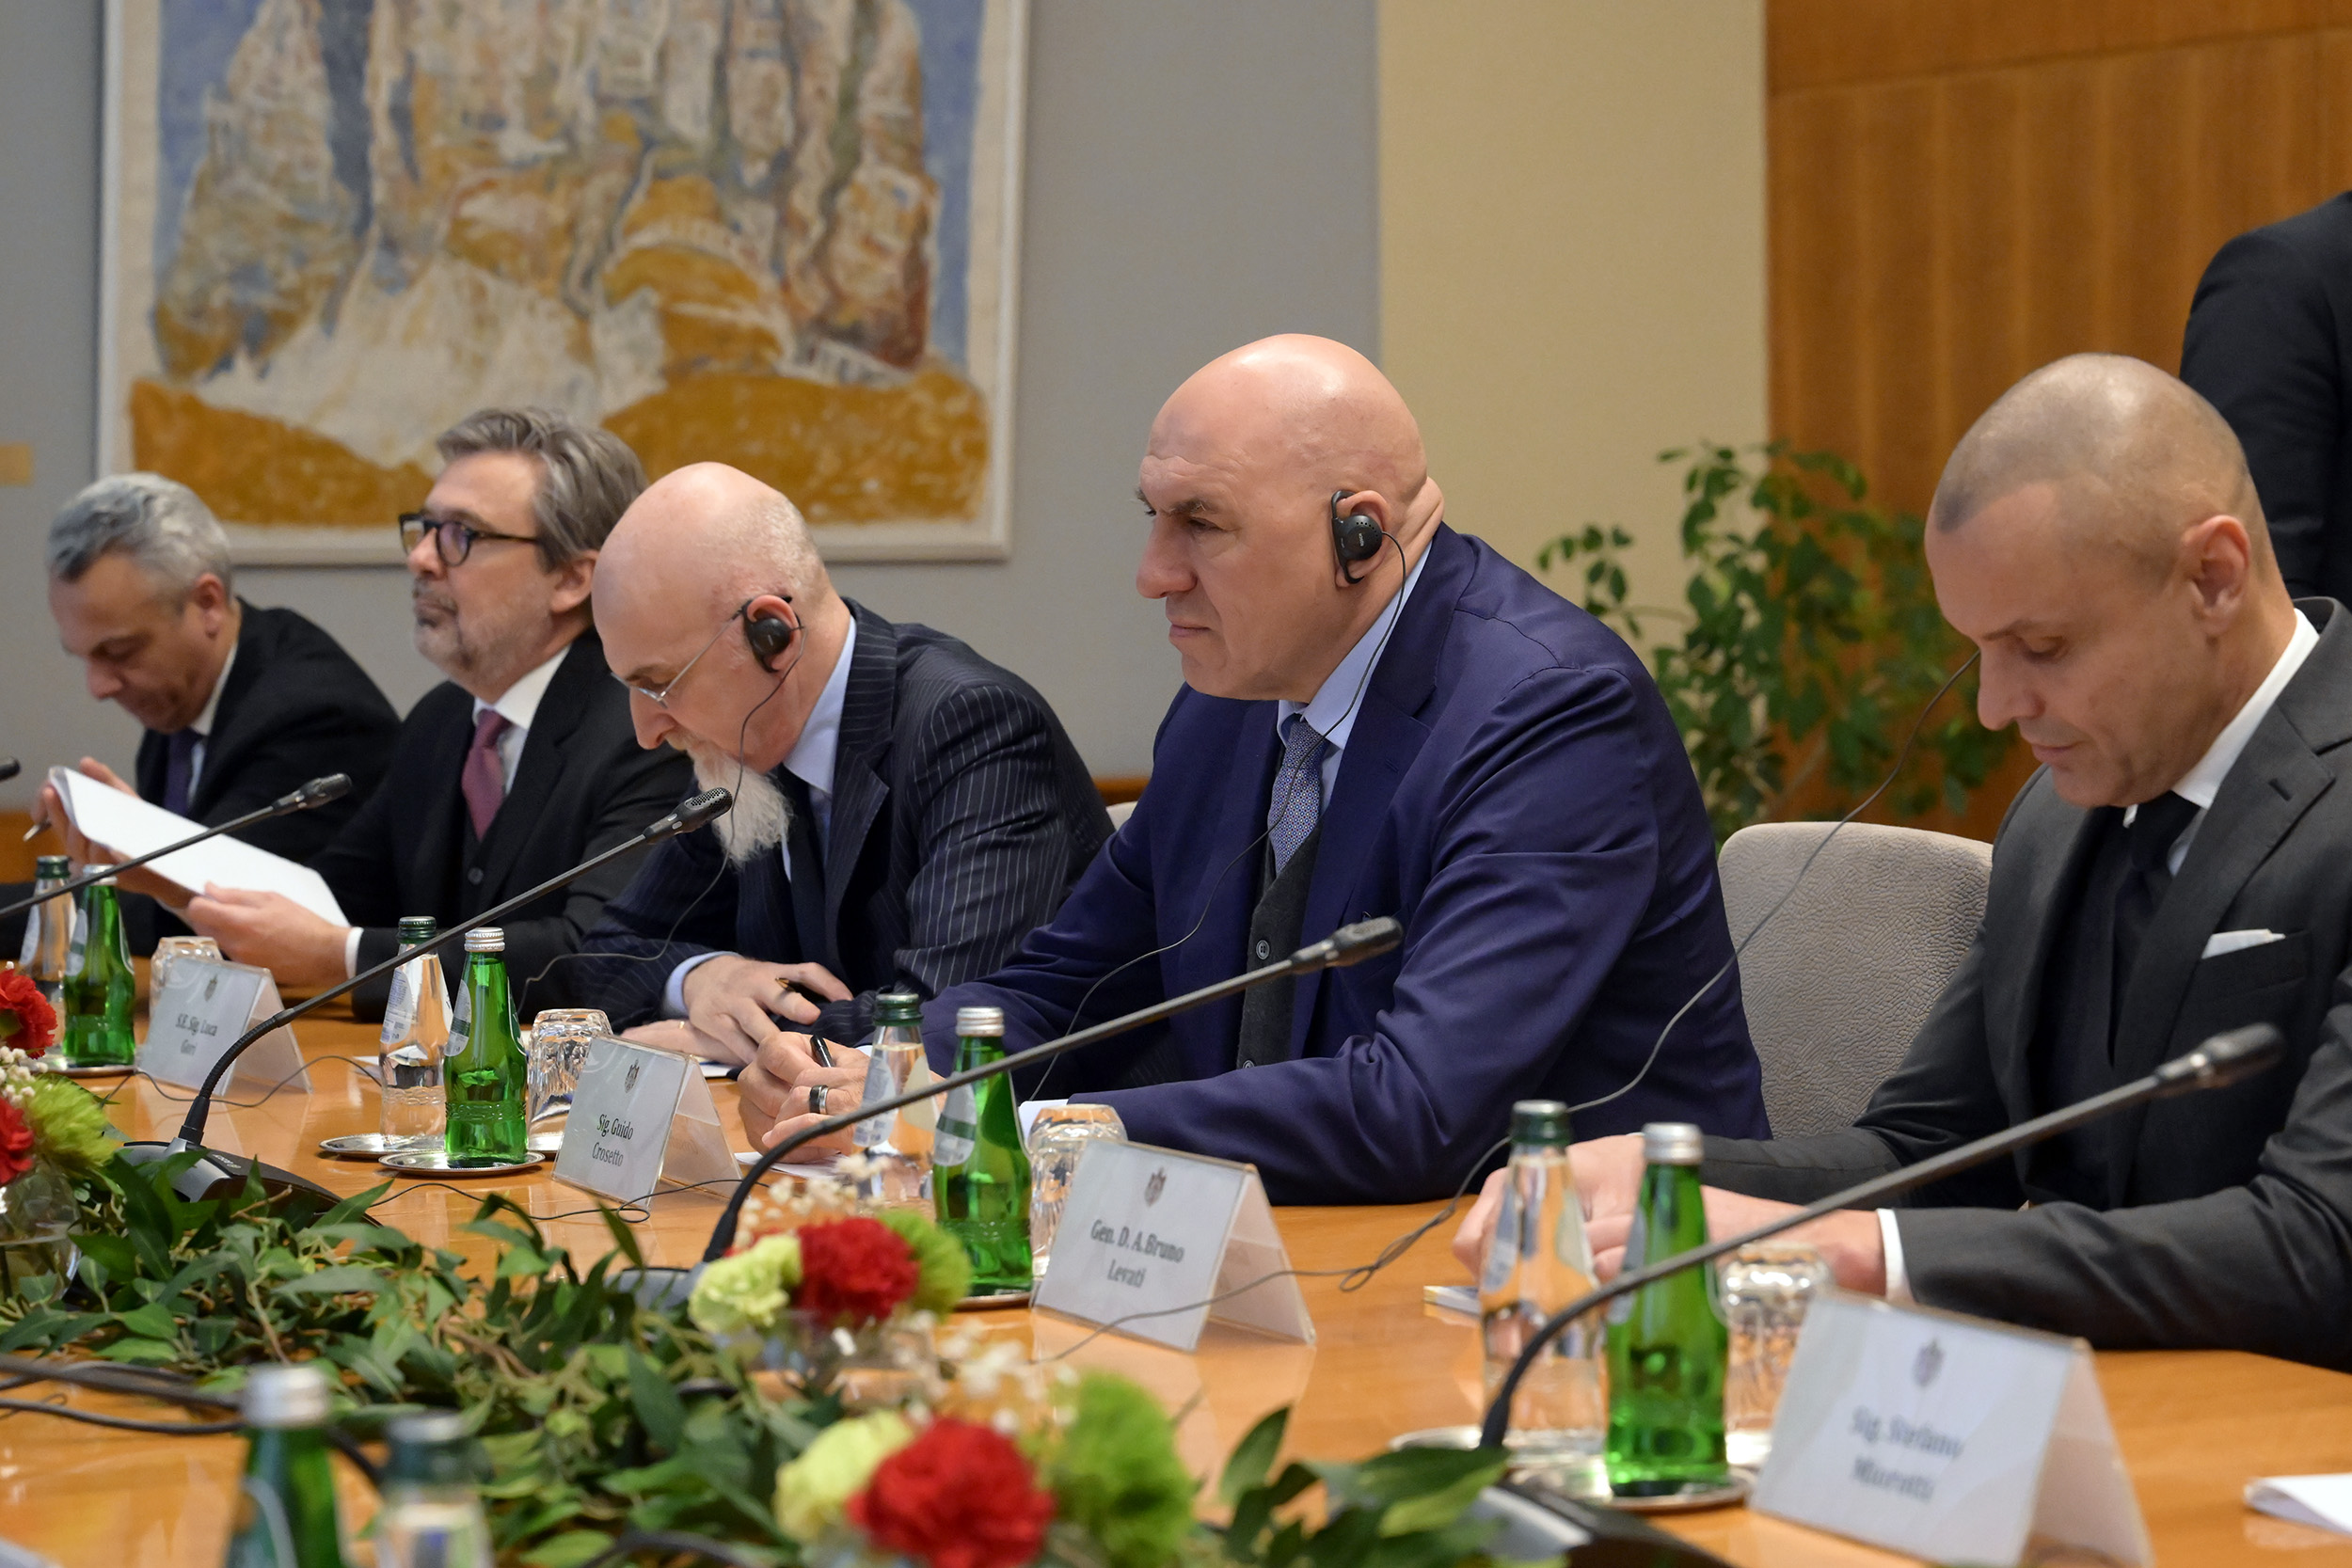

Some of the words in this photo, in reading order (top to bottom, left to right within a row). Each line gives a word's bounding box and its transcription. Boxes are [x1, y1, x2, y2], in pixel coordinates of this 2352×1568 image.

[596, 1114, 610, 1137] Sig.
[611, 1118, 634, 1140] Guido
[592, 1142, 624, 1166] Crosetto
[1090, 1219, 1116, 1244] Gen.
[1106, 1259, 1147, 1288] Levati
